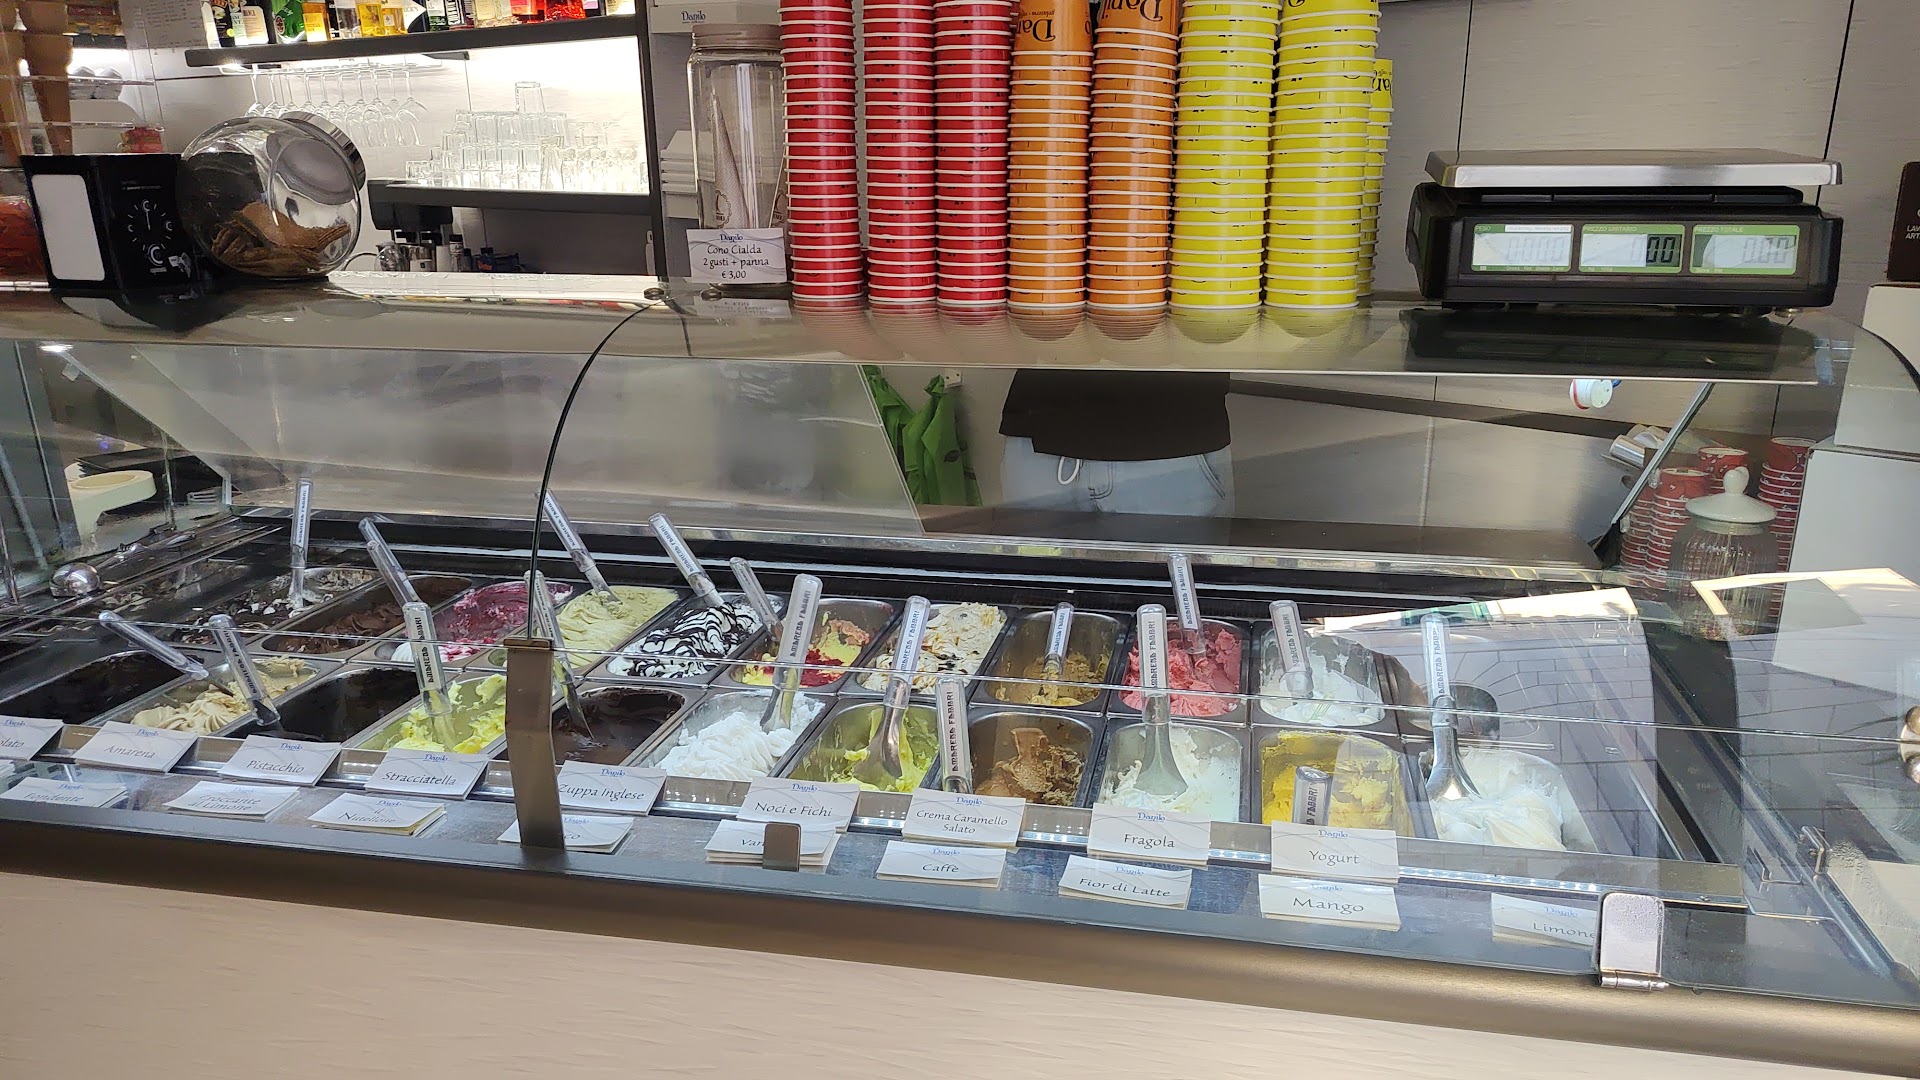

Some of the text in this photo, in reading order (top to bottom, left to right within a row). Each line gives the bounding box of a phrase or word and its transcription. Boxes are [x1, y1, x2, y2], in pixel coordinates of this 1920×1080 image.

[681, 10, 706, 21] Danilo
[720, 233, 743, 242] Danilo
[707, 244, 762, 254] Cono Cialda
[703, 258, 709, 266] 2
[709, 258, 729, 269] gusti
[740, 258, 769, 269] panna
[721, 271, 747, 279] € 3,00
[1148, 620, 1157, 651] FABBRI
[946, 691, 959, 772] AMARENA FABBRI
[104, 745, 155, 759] Amarena
[246, 760, 305, 773] Pistacchio
[382, 771, 456, 785] Stracciatella
[600, 768, 626, 777] Danilo
[558, 784, 645, 802] Zuppa Inglese
[791, 783, 818, 792] Danilo
[955, 796, 983, 805] Danilo
[1306, 787, 1319, 817] FABBRI
[203, 802, 252, 811] Limone
[754, 802, 786, 813] Noci
[800, 806, 832, 817] Fichi
[916, 810, 1008, 826] Crema Caramello
[1137, 812, 1166, 822] Danilo
[942, 823, 976, 834] Salato
[1318, 829, 1349, 838] Danilo
[1124, 833, 1175, 849] Fragola
[931, 847, 961, 856] Danilo
[1309, 850, 1360, 866] Yogurt
[922, 863, 960, 873] Caffè
[1115, 866, 1144, 876] Danilo
[1079, 878, 1171, 897] Fior di Latte
[1293, 897, 1364, 915] Mango
[1544, 906, 1578, 917] Danilo
